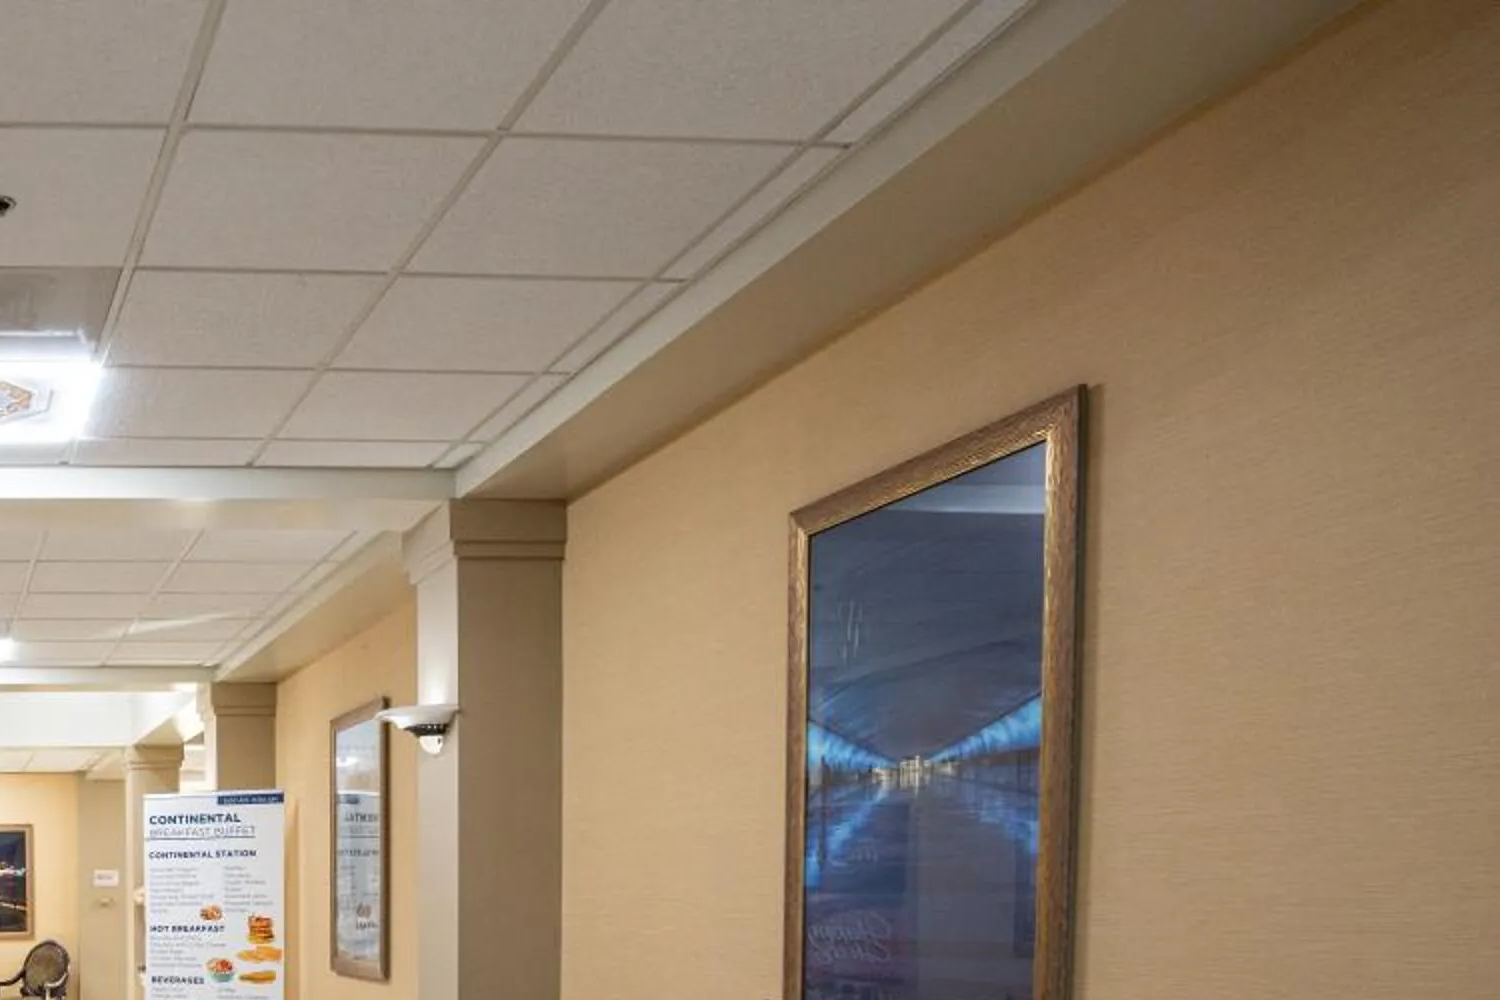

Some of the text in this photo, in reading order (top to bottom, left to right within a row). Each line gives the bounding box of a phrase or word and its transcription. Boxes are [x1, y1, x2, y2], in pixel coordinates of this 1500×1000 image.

[148, 812, 241, 825] CONTINENTAL
[148, 848, 257, 860] CONTINENTAL STATION
[150, 924, 225, 933] HOT BREAKFAST
[151, 975, 205, 985] BEVERAGES
